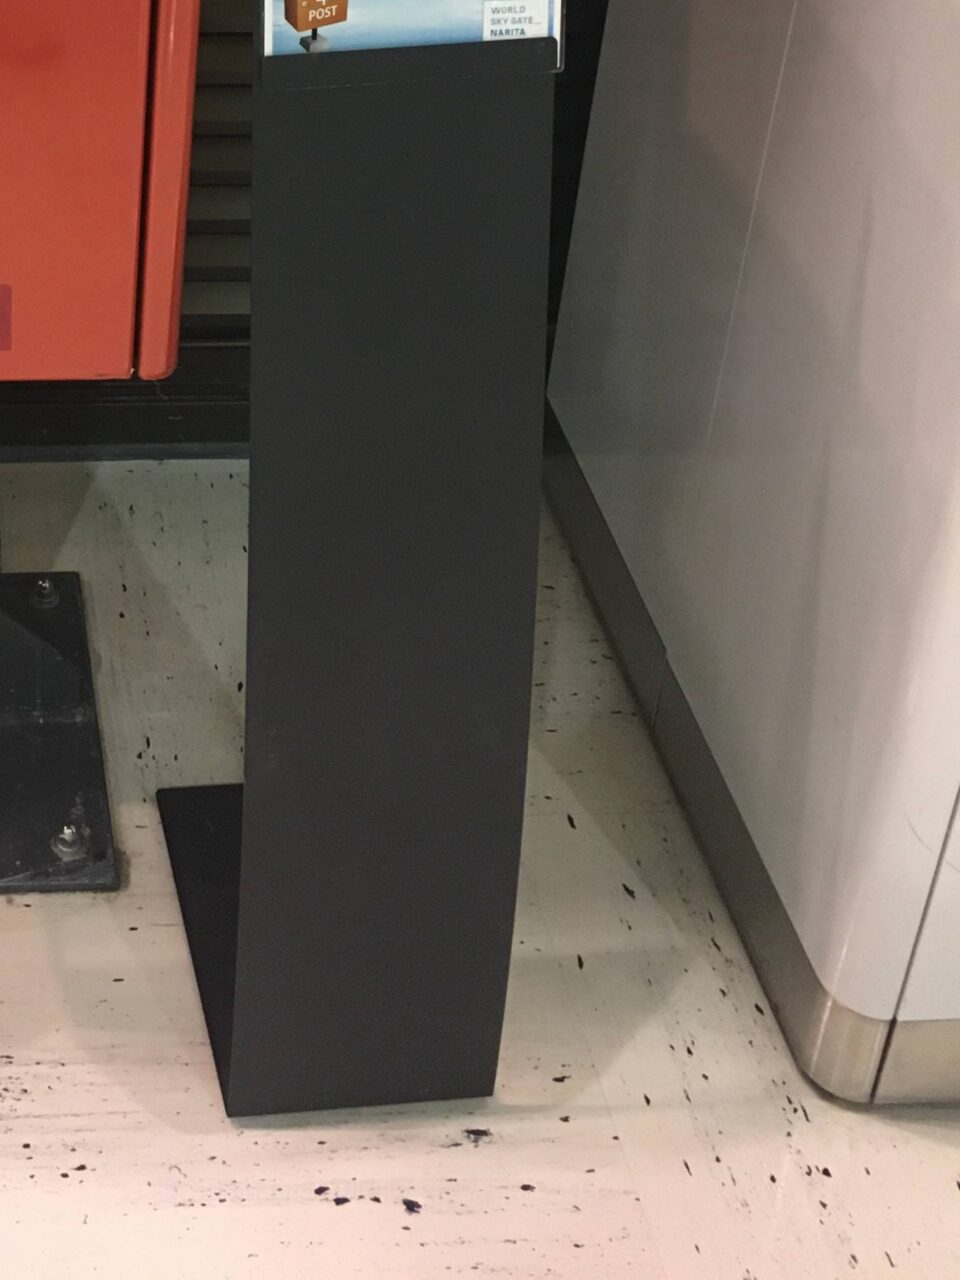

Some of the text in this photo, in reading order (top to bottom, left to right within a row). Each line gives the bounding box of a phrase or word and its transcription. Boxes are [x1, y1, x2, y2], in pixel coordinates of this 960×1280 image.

[309, 5, 338, 21] POST
[491, 6, 526, 15] WORLD
[491, 17, 508, 25] SKY
[490, 28, 526, 37] NARITA
